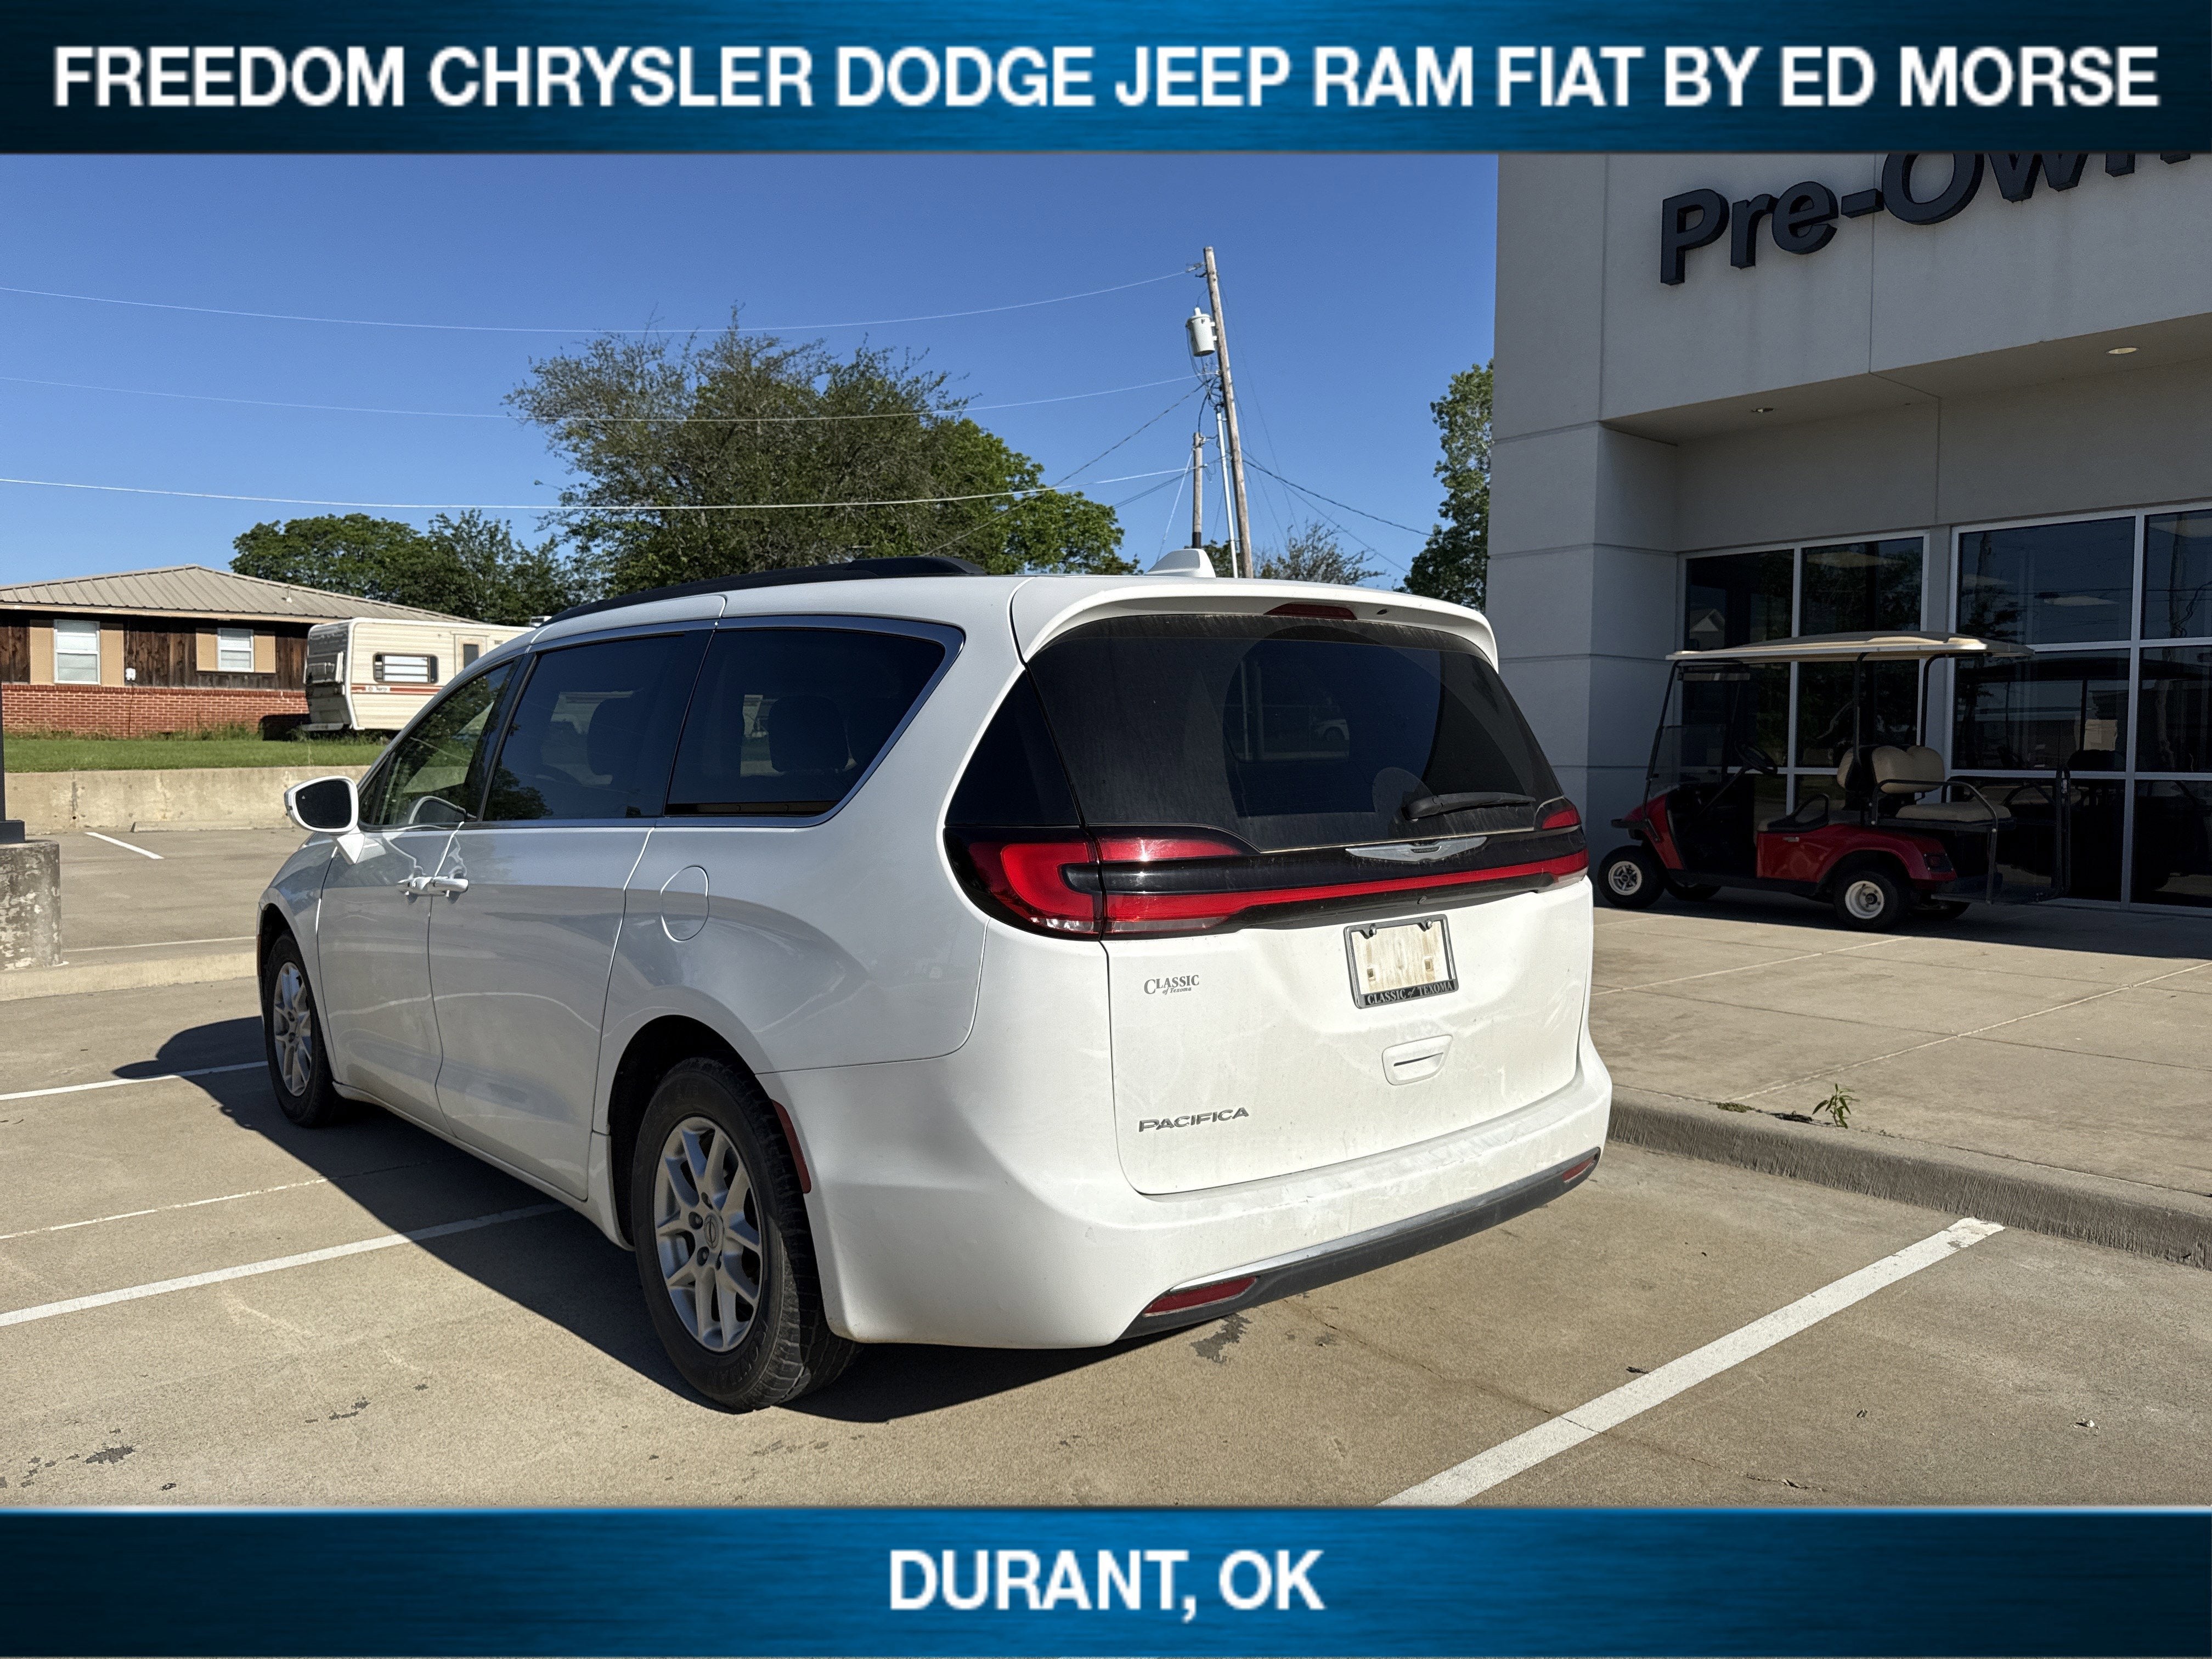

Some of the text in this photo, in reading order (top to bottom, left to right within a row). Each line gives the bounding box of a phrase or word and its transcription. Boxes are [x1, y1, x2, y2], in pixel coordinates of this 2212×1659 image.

[1660, 152, 2191, 286] Pre-Ow
[1143, 974, 1200, 995] CLASSIC
[1367, 980, 1454, 1005] CLASSIC of TEXOMA
[1138, 1107, 1250, 1133] PACIFICA
